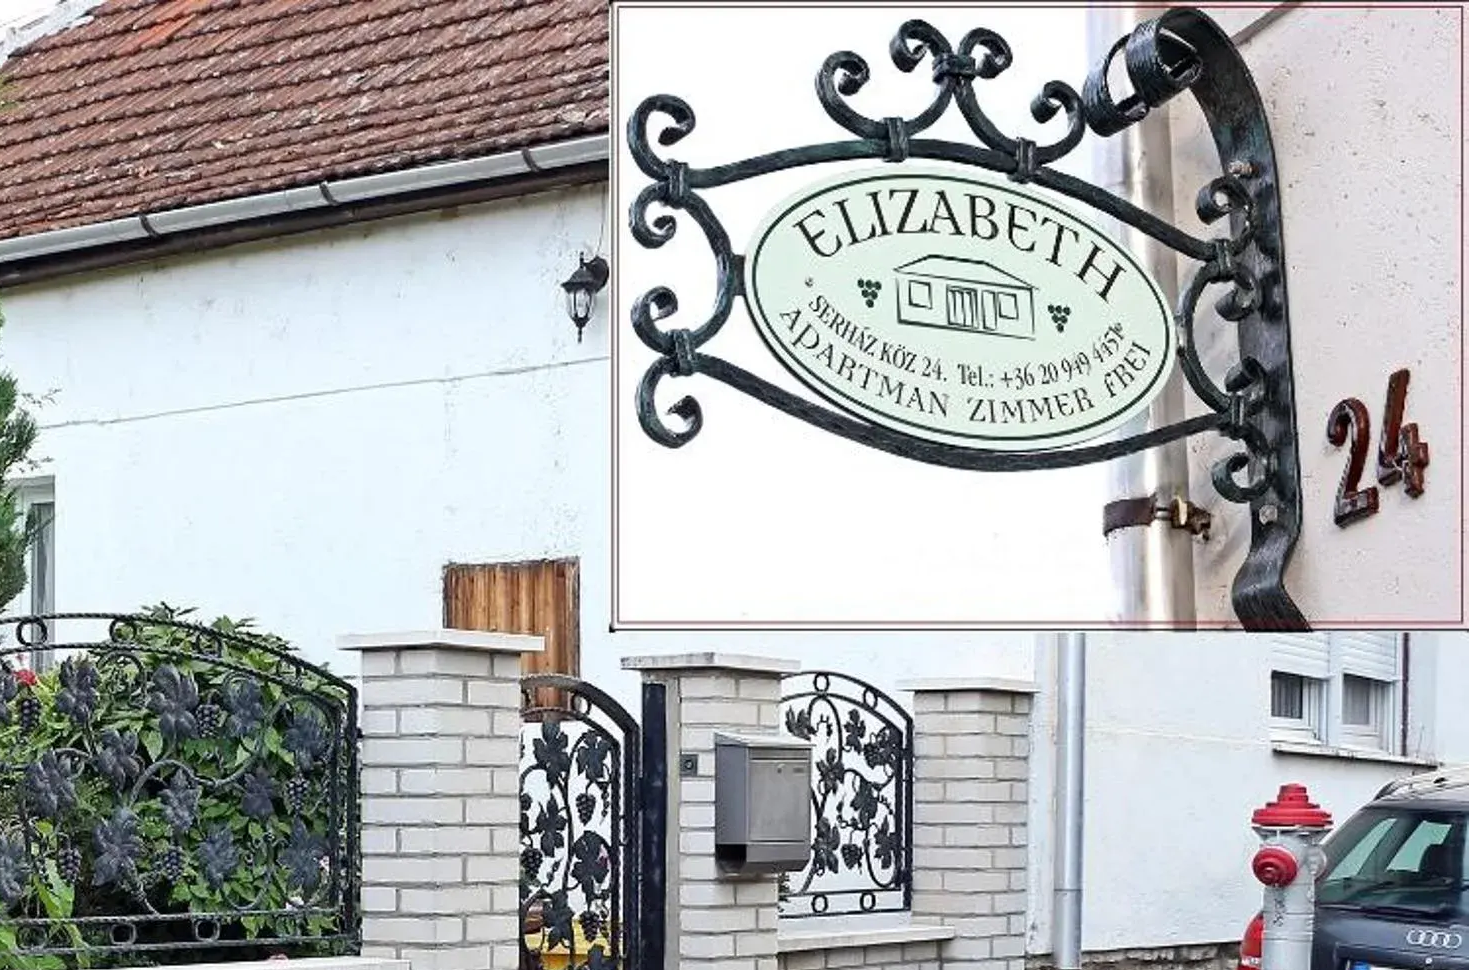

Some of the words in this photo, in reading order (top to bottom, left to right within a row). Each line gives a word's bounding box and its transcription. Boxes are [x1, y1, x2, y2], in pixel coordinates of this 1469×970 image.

[793, 188, 1128, 303] ELIZABETH
[779, 308, 951, 418] APARTMAN
[966, 387, 1096, 424] ZIMMER
[1103, 341, 1152, 399] FREI
[808, 295, 879, 357] SERHÁZ
[880, 342, 918, 374] KÖZ
[921, 356, 948, 383] 24.
[957, 363, 995, 389] Tel.:
[1000, 362, 1035, 390] +36
[1038, 361, 1060, 385] 20
[1061, 352, 1092, 382] 949
[1326, 368, 1430, 529] 24
